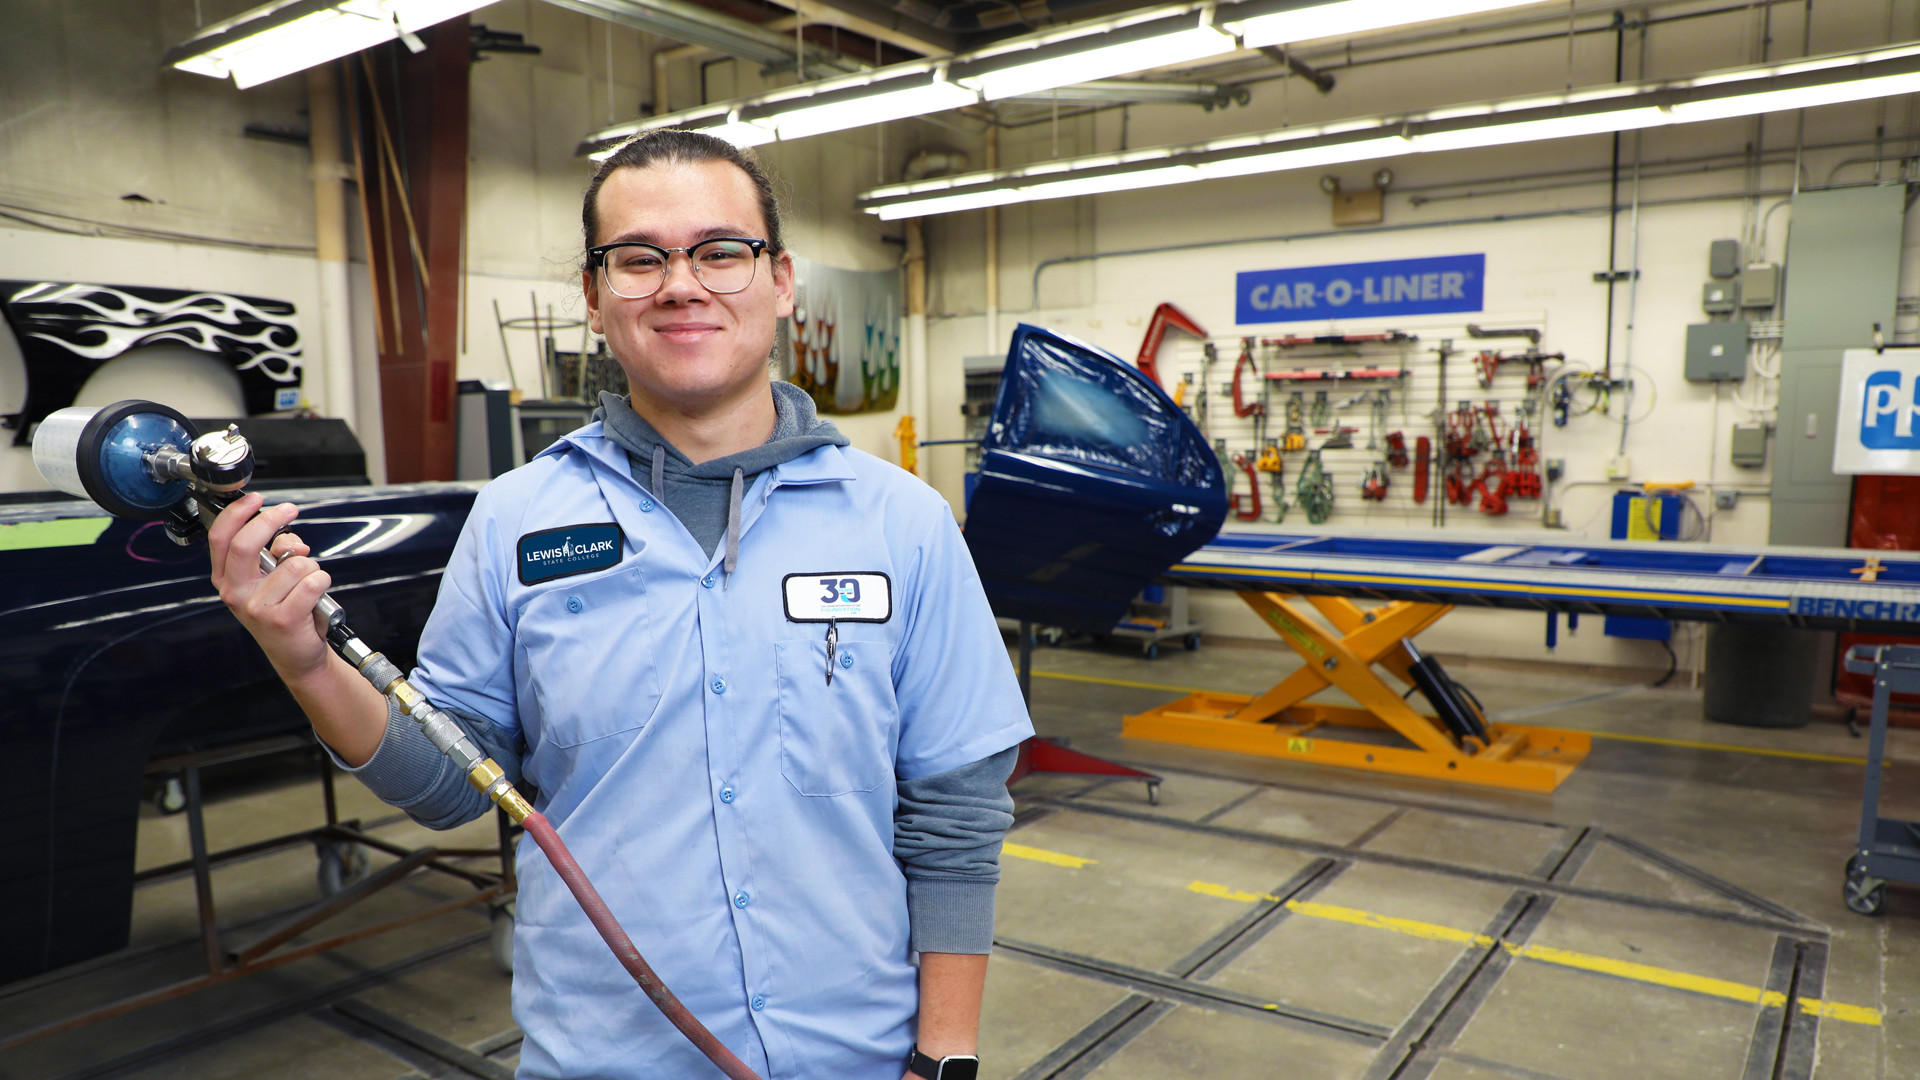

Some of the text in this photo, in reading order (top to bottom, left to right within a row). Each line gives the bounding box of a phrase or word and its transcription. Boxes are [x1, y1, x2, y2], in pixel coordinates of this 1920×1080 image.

[1250, 271, 1466, 312] CAR-O-LINER
[526, 540, 614, 562] LEWIS CLARK
[542, 552, 600, 566] STATE COLLEGE
[819, 578, 861, 604] 30
[1798, 597, 1920, 622] BENCHR
